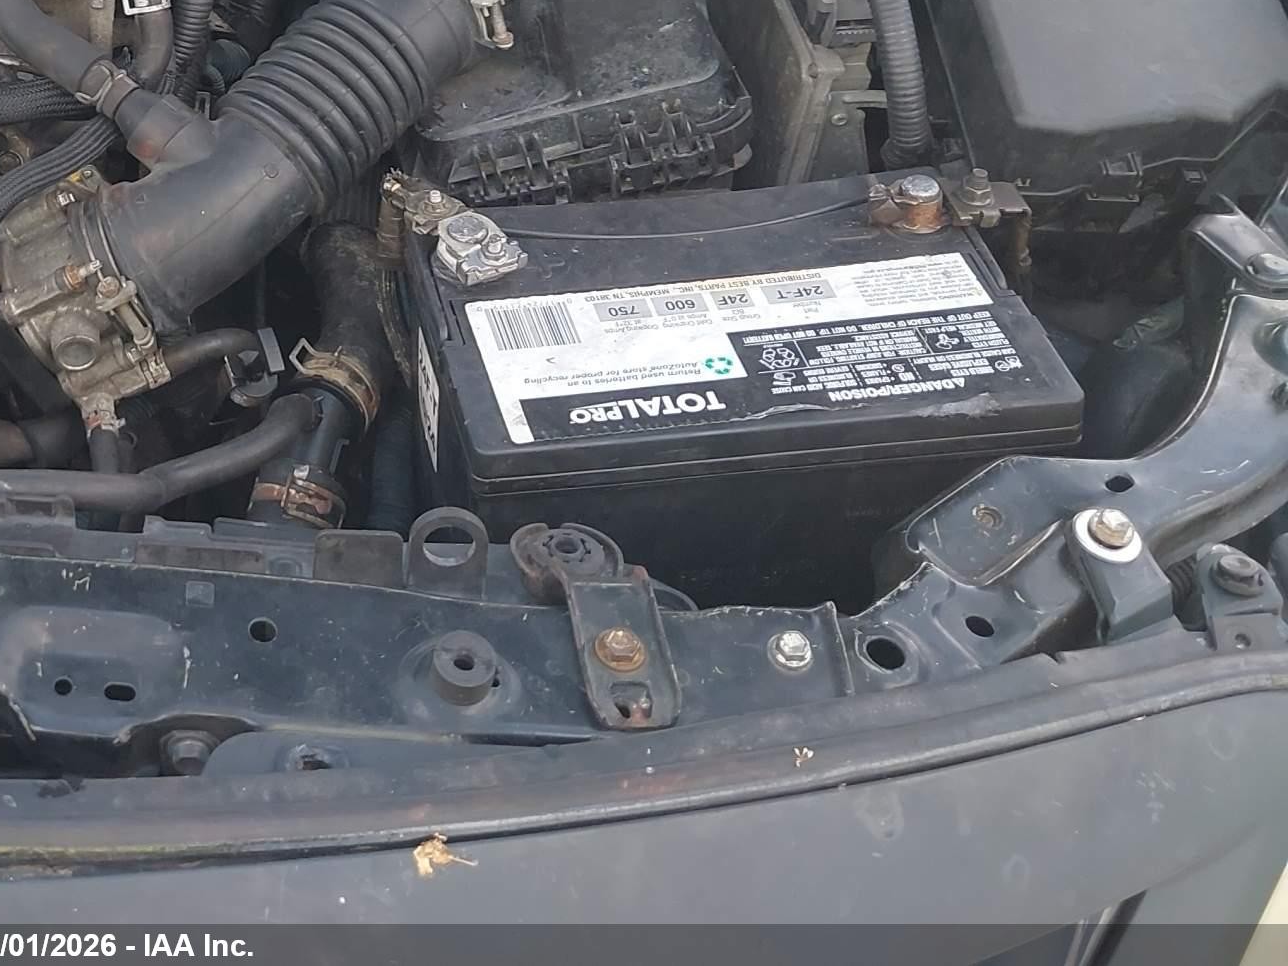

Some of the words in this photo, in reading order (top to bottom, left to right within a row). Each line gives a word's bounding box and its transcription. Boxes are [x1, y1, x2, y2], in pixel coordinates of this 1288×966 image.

[749, 277, 764, 285] BY
[763, 271, 822, 283] DISTRIBUTED
[725, 279, 750, 287] BEST
[772, 285, 824, 298] 24F-T
[583, 293, 611, 302] 38103
[714, 293, 750, 305] 24F
[662, 298, 697, 310] 600
[606, 305, 639, 317] 750
[569, 370, 604, 379] proper
[621, 366, 648, 374] store
[640, 371, 665, 379] used
[667, 368, 702, 377] Return
[522, 374, 568, 384] recycling
[593, 374, 639, 384] batteries
[828, 379, 957, 401] DANGER/POISON
[569, 391, 726, 423] TOTALPRO
